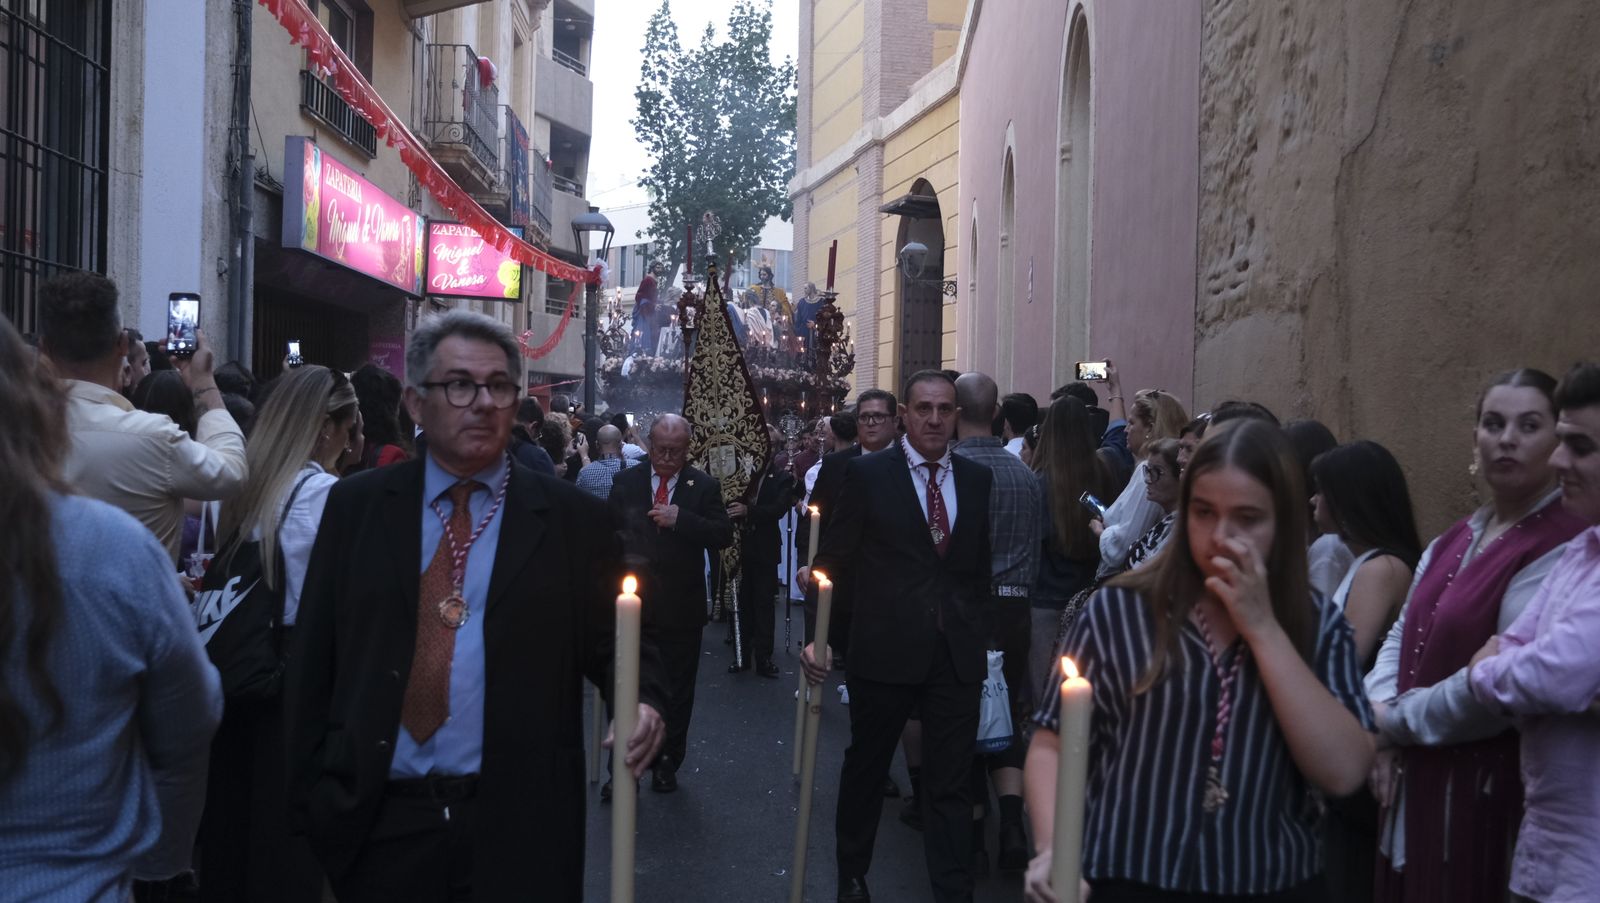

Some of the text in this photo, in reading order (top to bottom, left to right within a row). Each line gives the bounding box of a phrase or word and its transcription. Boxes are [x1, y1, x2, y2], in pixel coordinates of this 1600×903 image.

[325, 163, 362, 204] ZAPATERIA
[327, 198, 361, 258] Miguel
[362, 204, 371, 244] &
[432, 224, 482, 238] ZAPATE
[433, 239, 484, 265] Miguel
[456, 258, 470, 276] &
[431, 272, 487, 291] Vanesa
